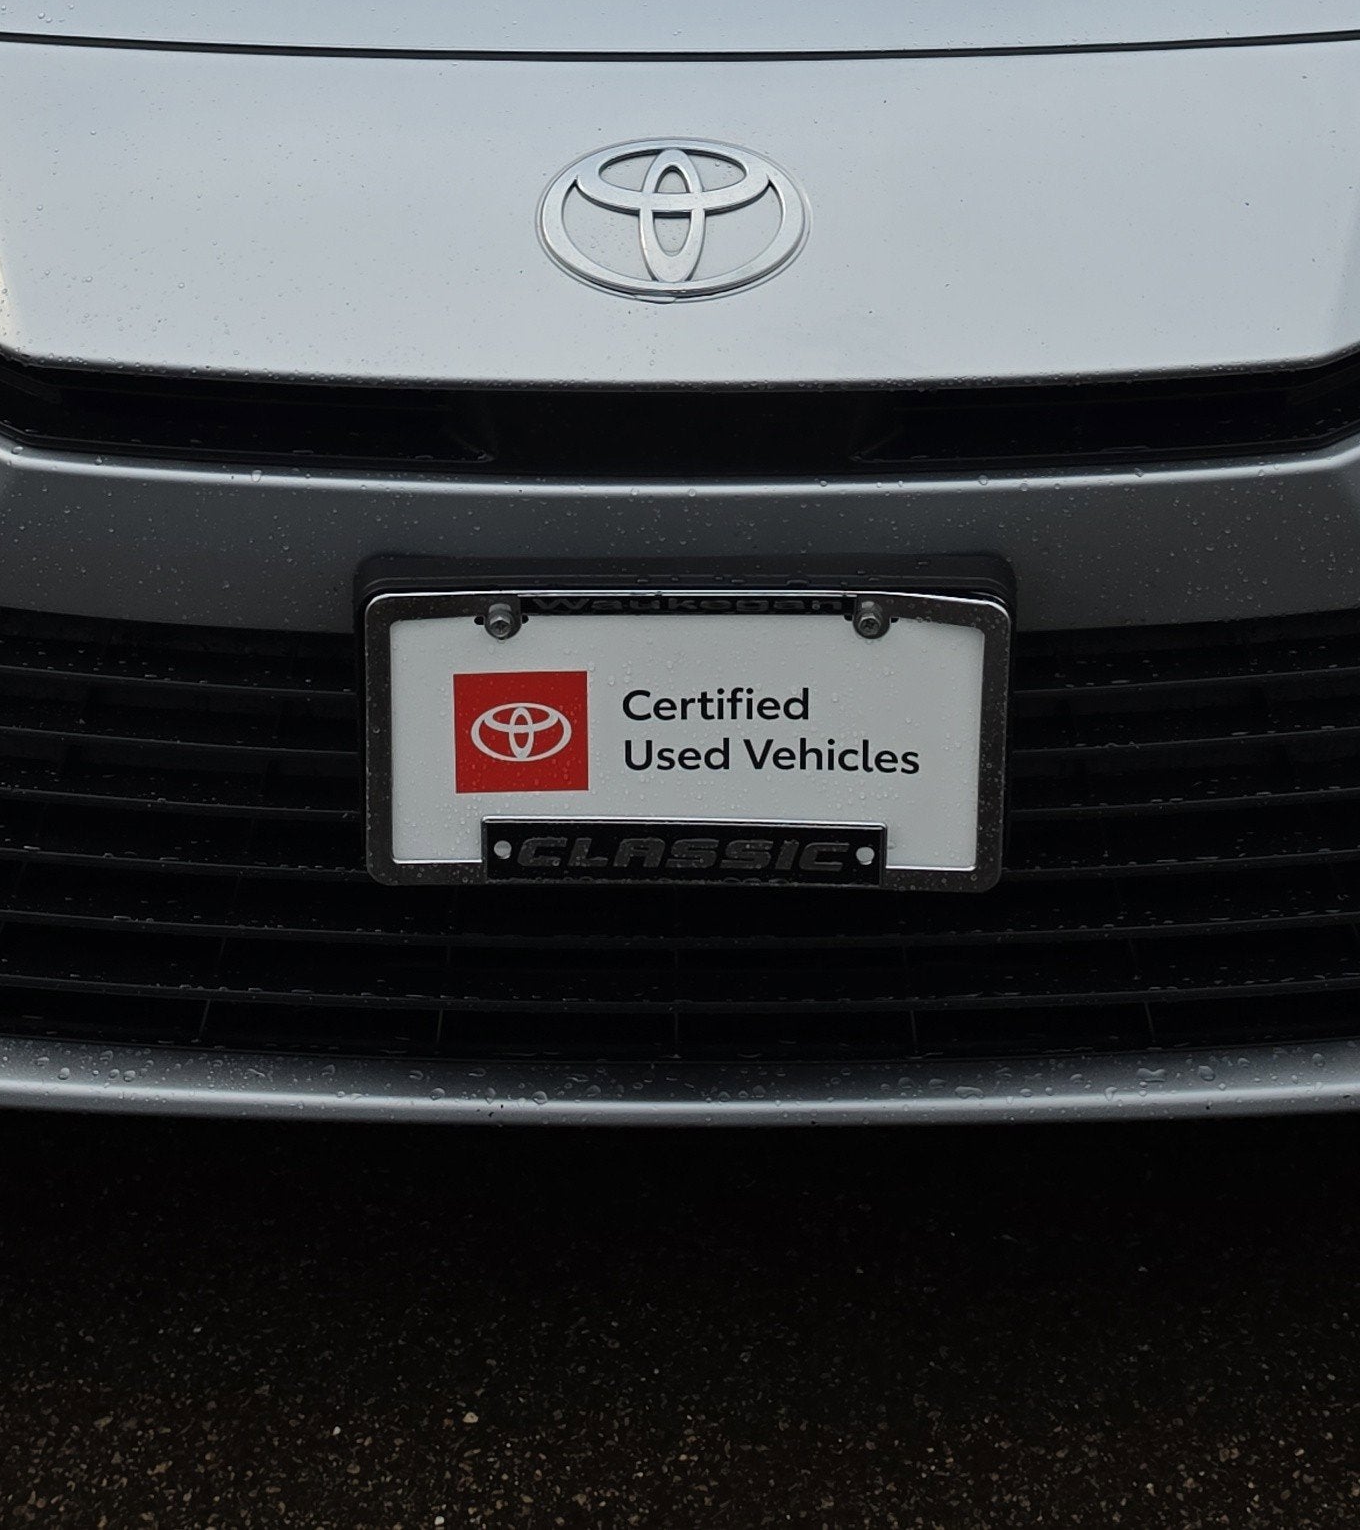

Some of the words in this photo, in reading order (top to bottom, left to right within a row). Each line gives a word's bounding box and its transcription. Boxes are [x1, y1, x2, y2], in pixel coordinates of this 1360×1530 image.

[622, 687, 810, 721] Certified
[624, 738, 731, 771] Used
[743, 737, 920, 775] Vehicles
[516, 836, 851, 872] CLASSIC
